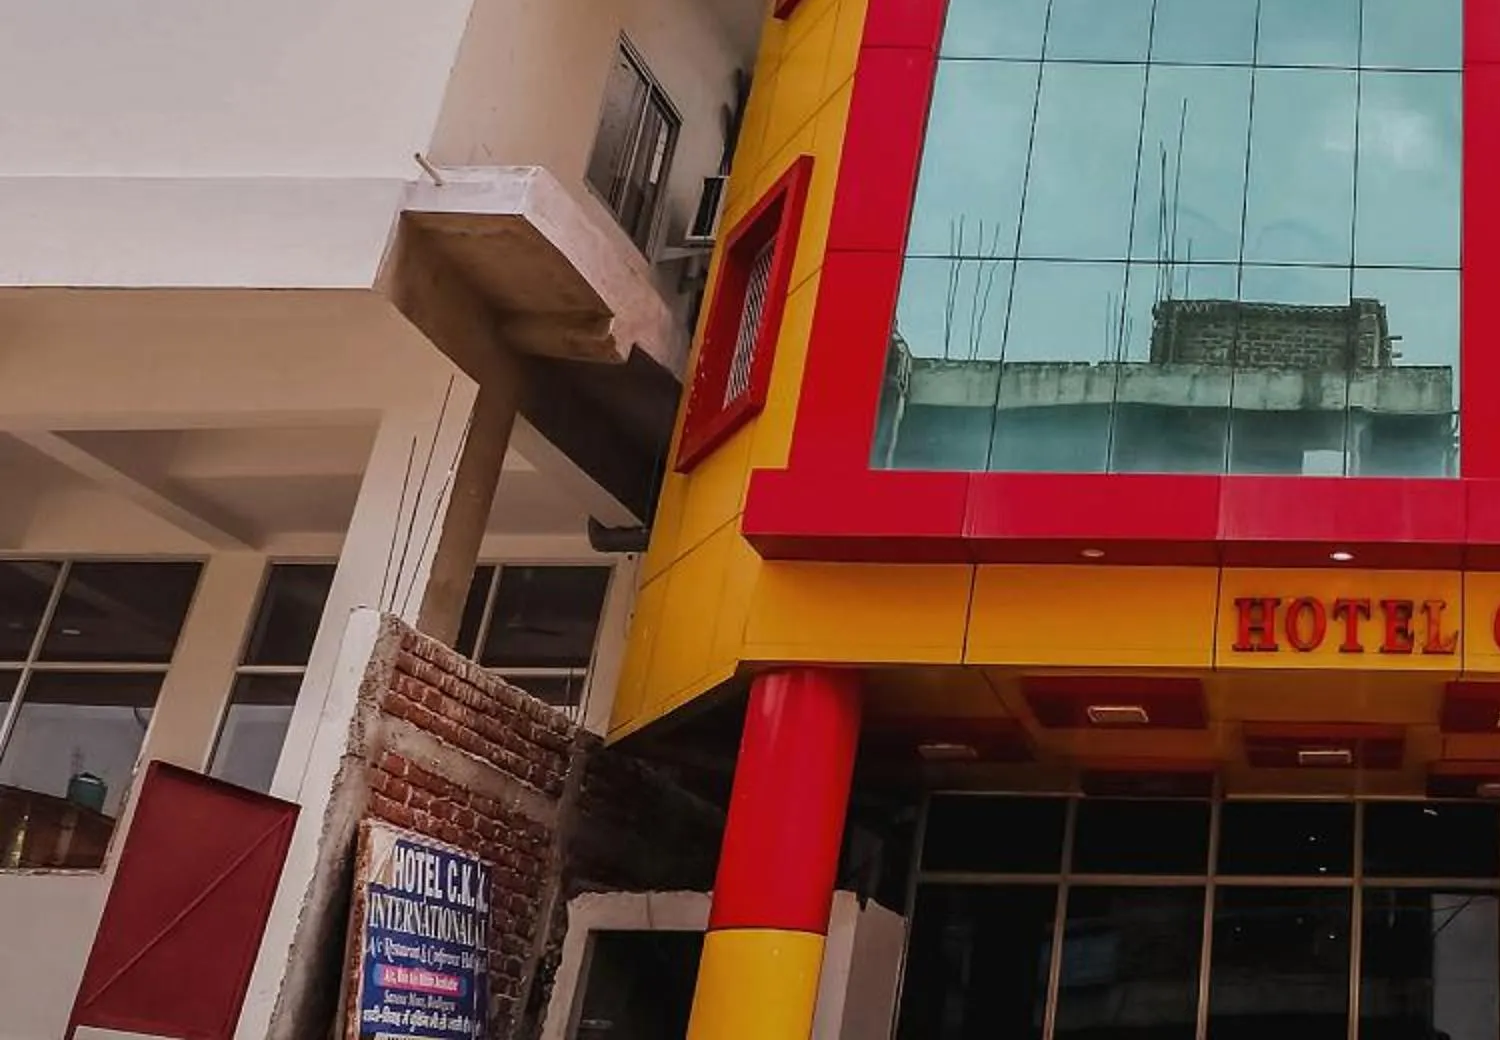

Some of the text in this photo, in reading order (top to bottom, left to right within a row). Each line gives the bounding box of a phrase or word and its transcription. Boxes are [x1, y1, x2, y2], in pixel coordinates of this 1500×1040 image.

[1232, 596, 1459, 655] HOTEL
[392, 845, 442, 899] HOTEL
[369, 892, 475, 947] INTERNATIONAL
